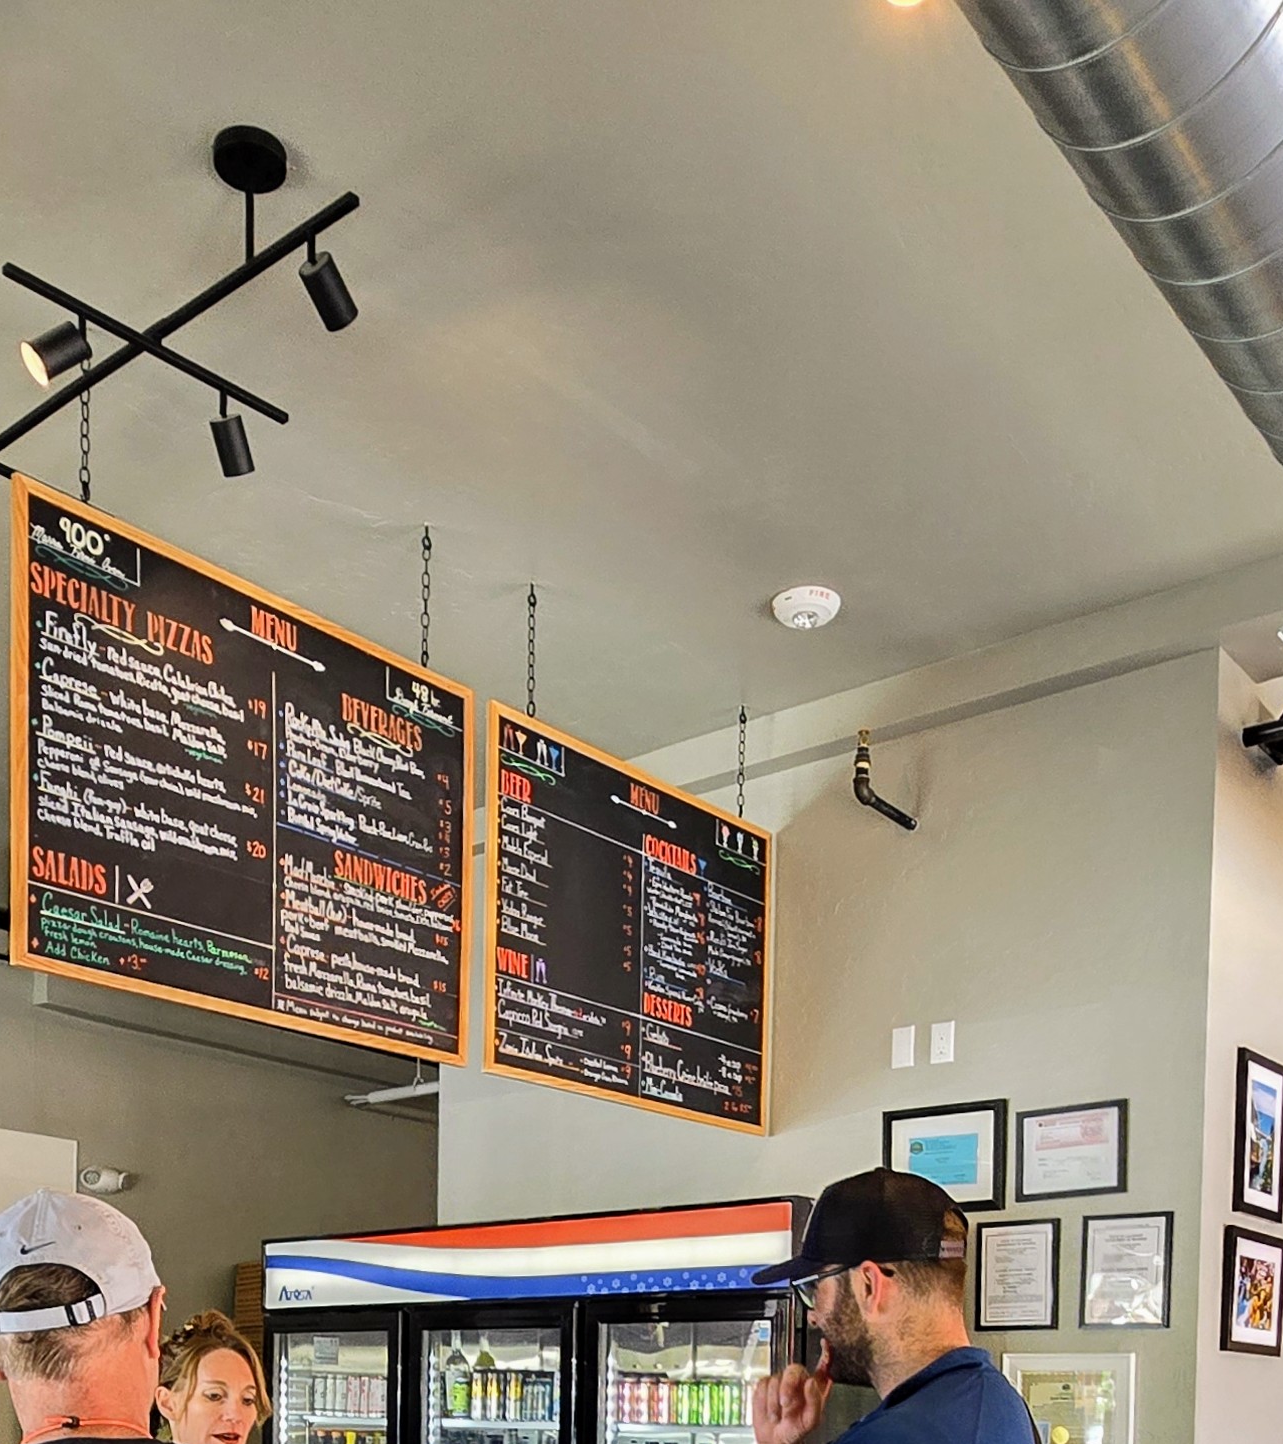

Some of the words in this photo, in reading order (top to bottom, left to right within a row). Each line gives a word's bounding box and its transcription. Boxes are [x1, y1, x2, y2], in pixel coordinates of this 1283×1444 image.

[30, 562, 135, 632] SPECIALTY
[147, 611, 213, 664] PIZZAS
[251, 606, 297, 651] MENU
[44, 610, 97, 662] Firefly
[41, 656, 98, 700] Caprese
[41, 714, 93, 754] Pompeii
[342, 693, 422, 751] BEVERAGES
[501, 769, 531, 803] BEER
[630, 783, 659, 815] MENU
[32, 846, 106, 894] SALADS
[645, 835, 696, 875] COCKTAILS
[334, 850, 427, 904] SANDWICHES
[40, 891, 88, 923] Caesar
[89, 905, 121, 931] Salad
[45, 940, 67, 957] Add
[496, 946, 528, 978] WINE
[643, 992, 692, 1027] DESSERTS
